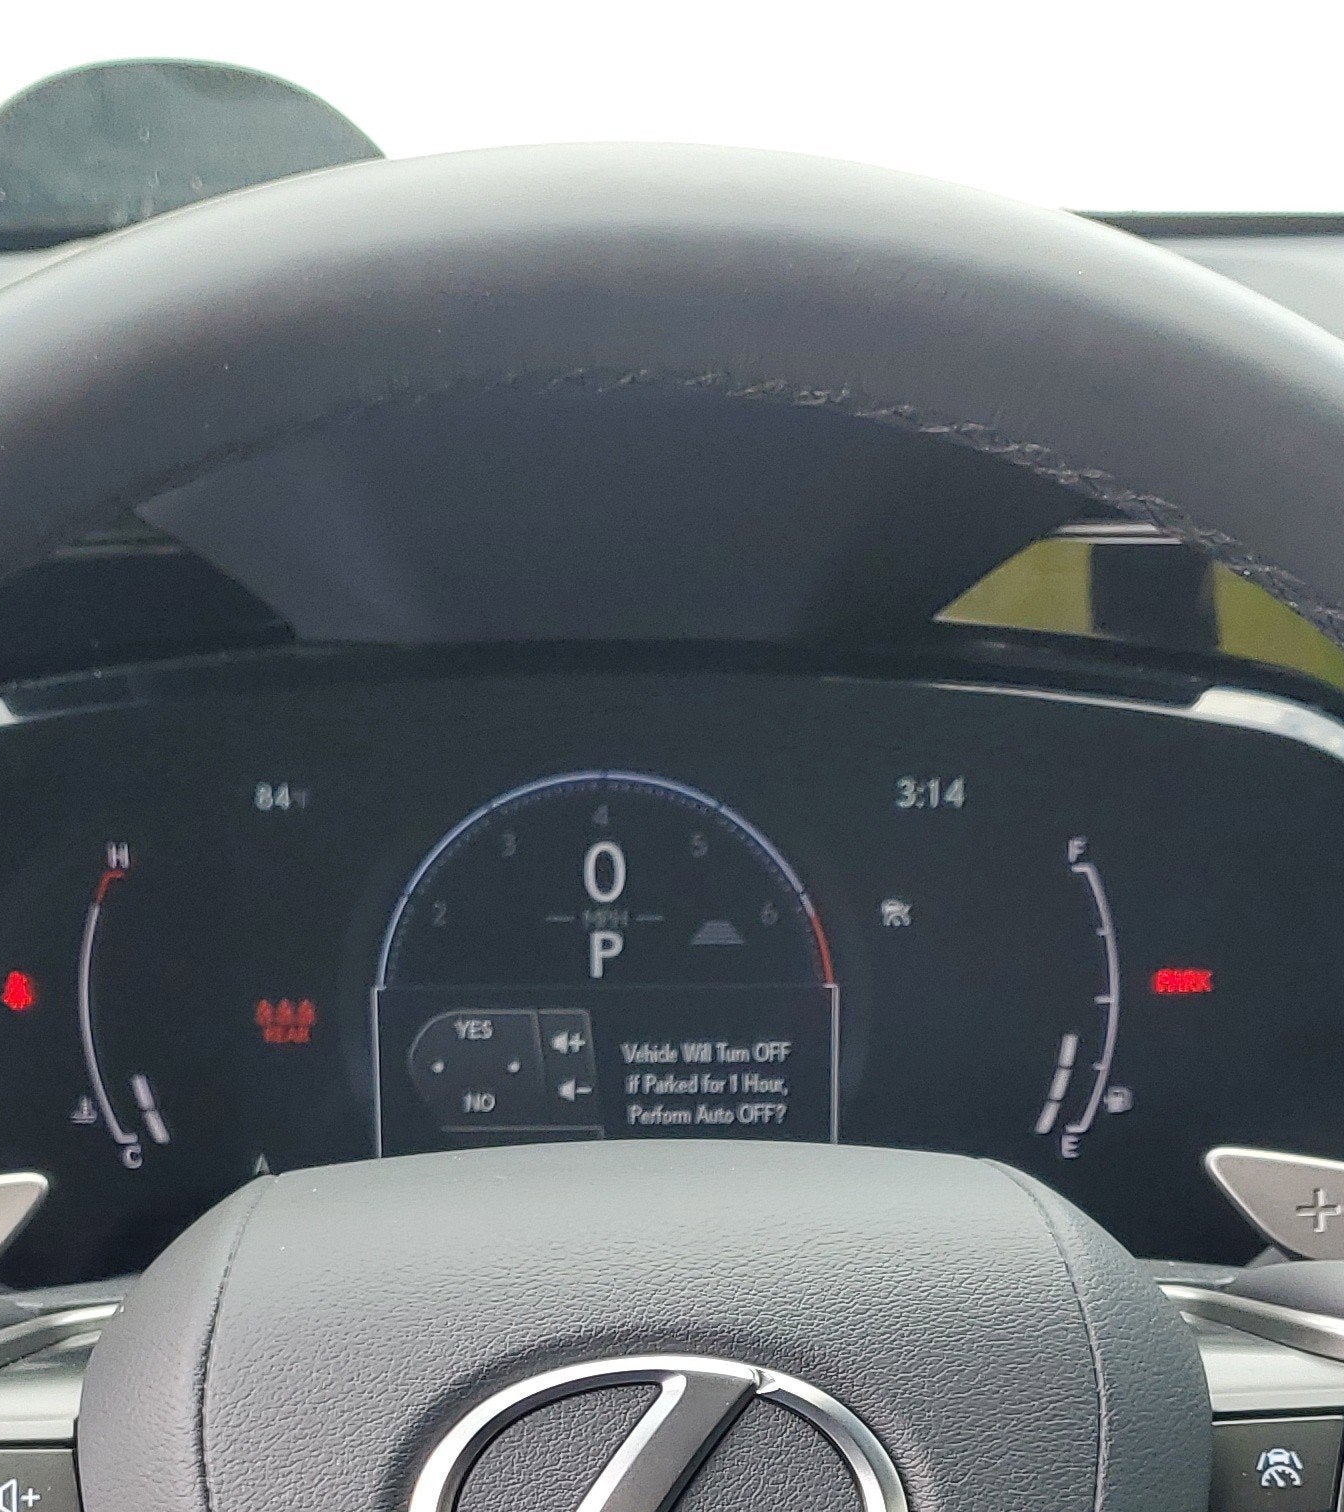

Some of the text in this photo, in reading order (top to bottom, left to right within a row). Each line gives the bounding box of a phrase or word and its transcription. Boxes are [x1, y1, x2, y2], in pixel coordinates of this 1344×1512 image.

[896, 777, 966, 808] 3:14
[592, 804, 610, 826] 4
[107, 841, 130, 869] H
[501, 834, 517, 857] 3
[692, 835, 709, 857] 5
[1068, 836, 1088, 862] F
[583, 840, 627, 903] 0
[432, 902, 448, 925] 2
[761, 902, 778, 924] 6
[589, 930, 624, 978] P
[455, 1020, 493, 1040] YES
[621, 1041, 792, 1064] Vehicle Will Turn OFF
[643, 1074, 698, 1094] Parked
[701, 1074, 726, 1093] for
[742, 1075, 789, 1097] Hour,
[463, 1092, 496, 1113] NO
[627, 1103, 788, 1126] Perform Auto OFF?
[123, 1145, 143, 1170] C
[1061, 1133, 1080, 1159] E
